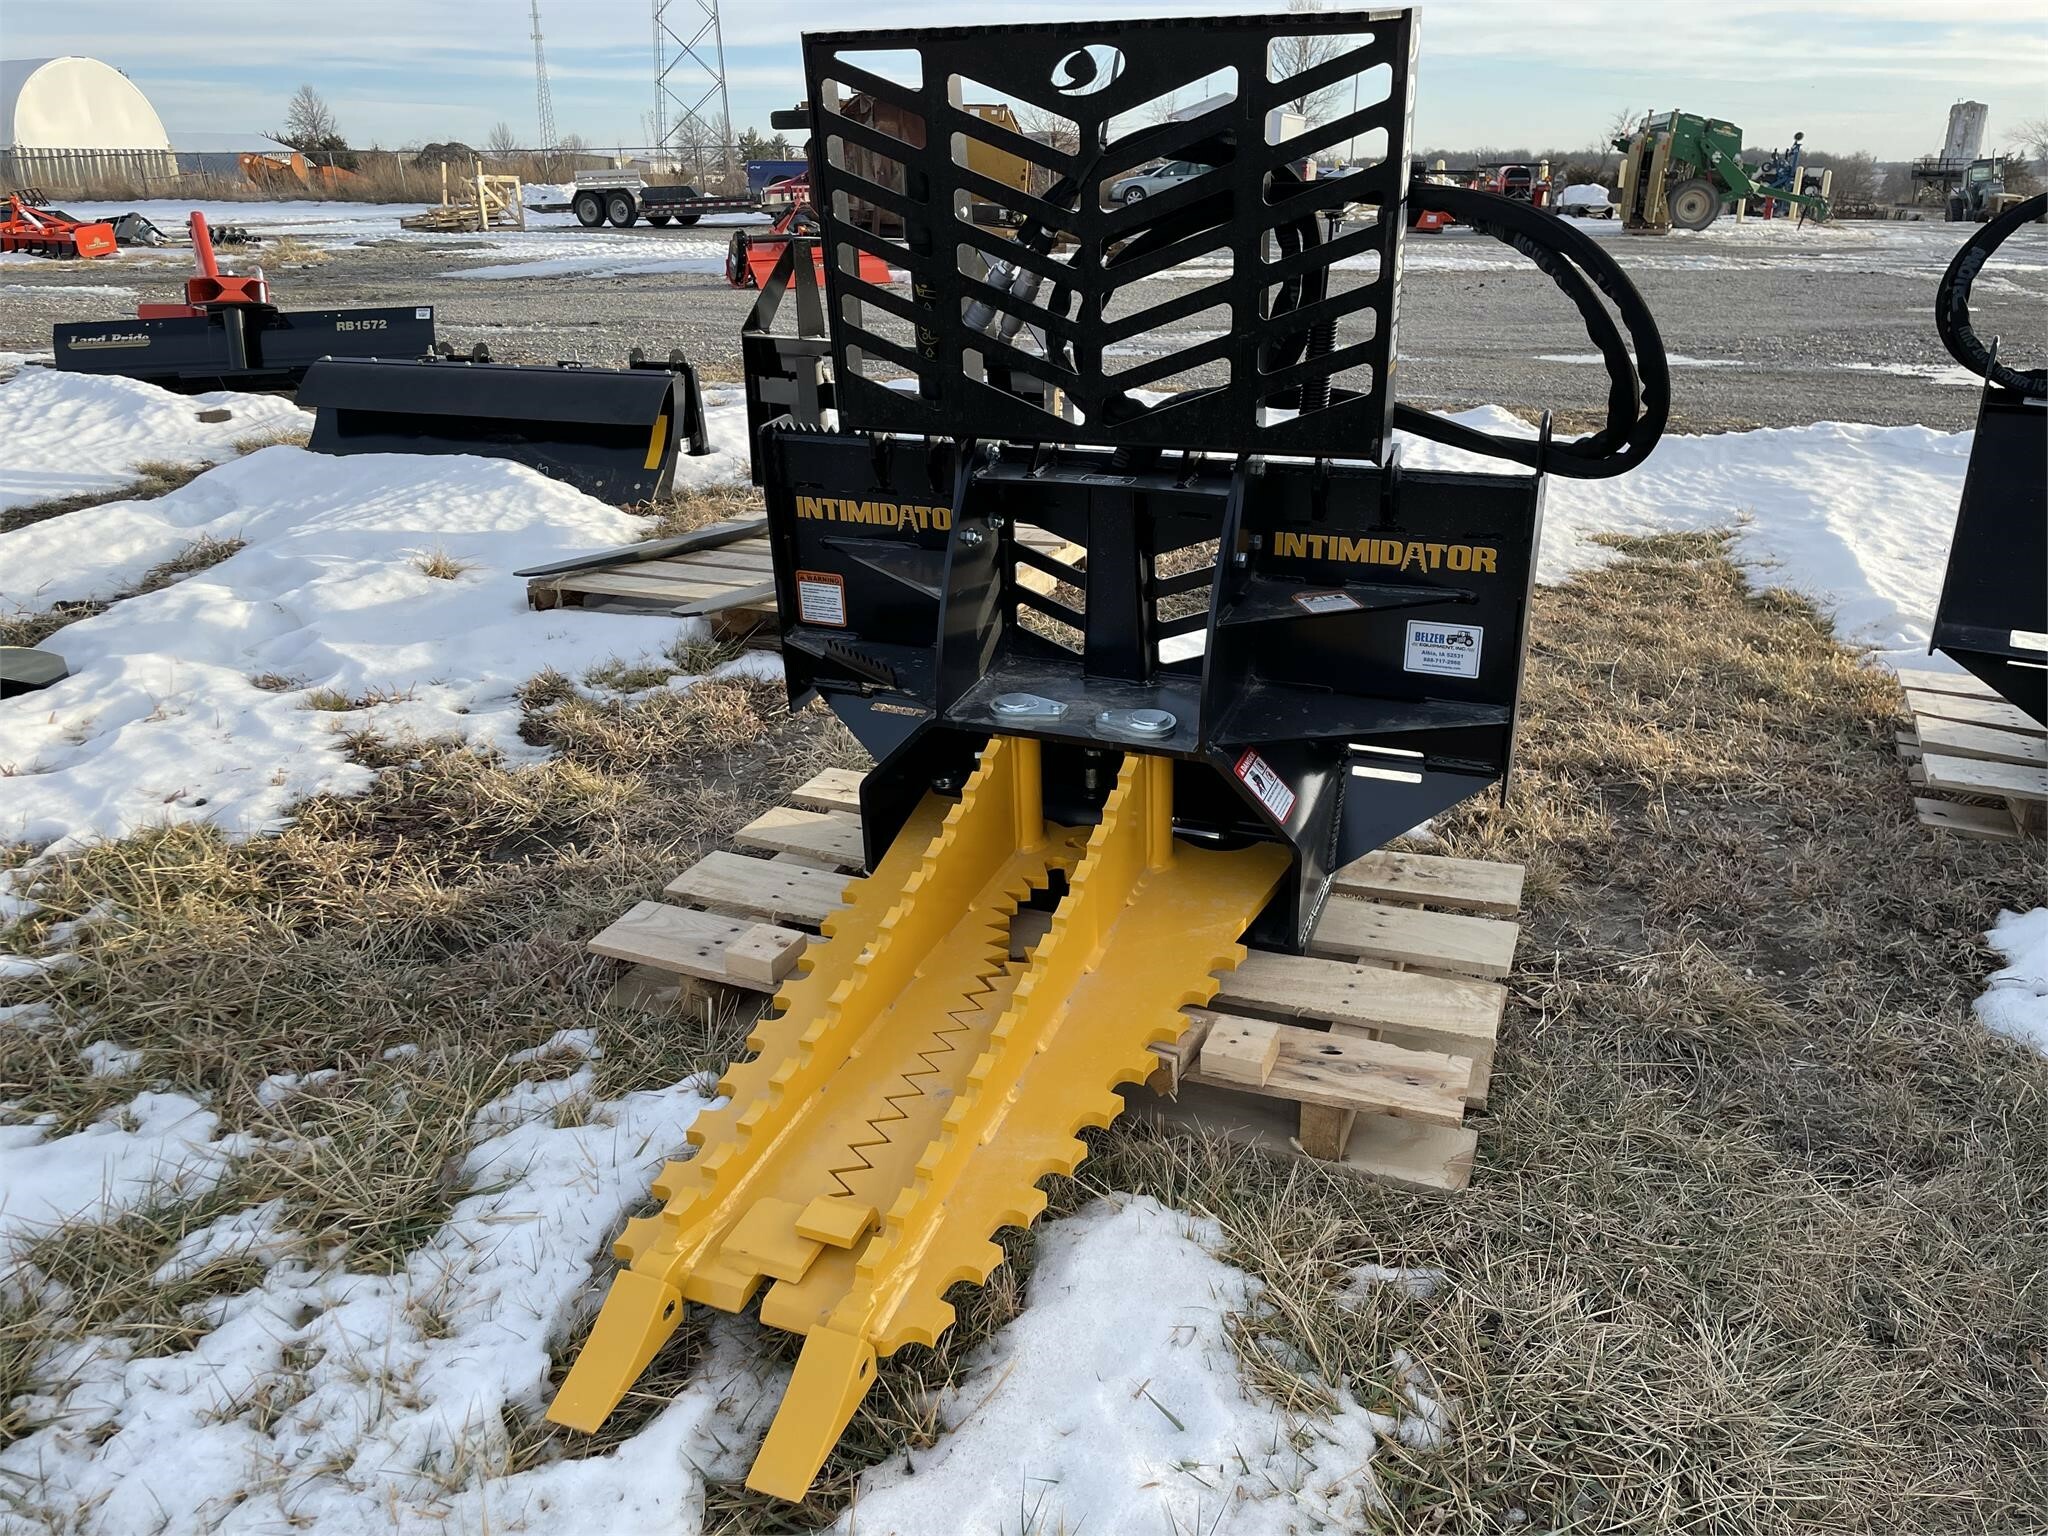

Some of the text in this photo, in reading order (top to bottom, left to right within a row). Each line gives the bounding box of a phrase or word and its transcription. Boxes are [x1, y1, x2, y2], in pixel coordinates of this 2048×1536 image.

[336, 320, 387, 331] RB1572
[796, 496, 953, 533] INTIMIDATO
[1275, 531, 1497, 574] INTIMIDATOR
[807, 575, 840, 584] WARNING
[1414, 631, 1445, 644] BELZER
